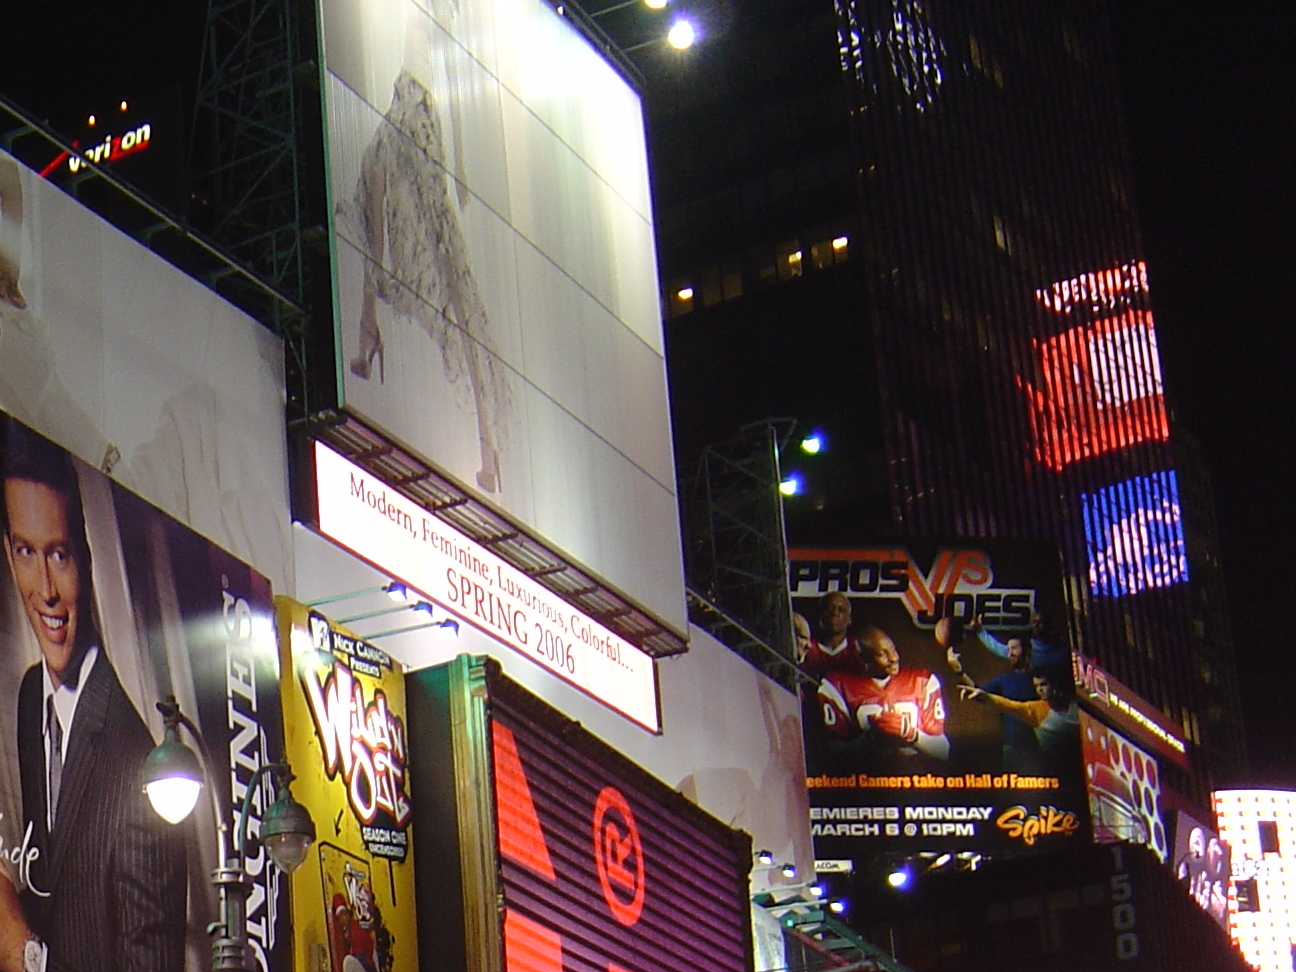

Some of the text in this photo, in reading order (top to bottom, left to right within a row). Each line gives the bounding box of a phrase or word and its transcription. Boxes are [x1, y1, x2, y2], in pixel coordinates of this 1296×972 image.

[349, 472, 418, 539] Modern,
[422, 518, 494, 587] Feminine,
[497, 565, 569, 634] Luxurious,
[790, 560, 909, 592] PROS
[916, 592, 1032, 626] JOES
[447, 568, 576, 674] SPRING 2006
[859, 774, 912, 788] Gamers
[913, 773, 945, 788] take
[946, 776, 964, 788] on
[966, 773, 992, 788] Hall
[994, 773, 1008, 788] of
[1009, 774, 1059, 788] Famers
[885, 823, 900, 836] 6
[922, 822, 975, 836] 10PM
[905, 806, 993, 820] MONDAY
[996, 805, 1079, 845] Spike
